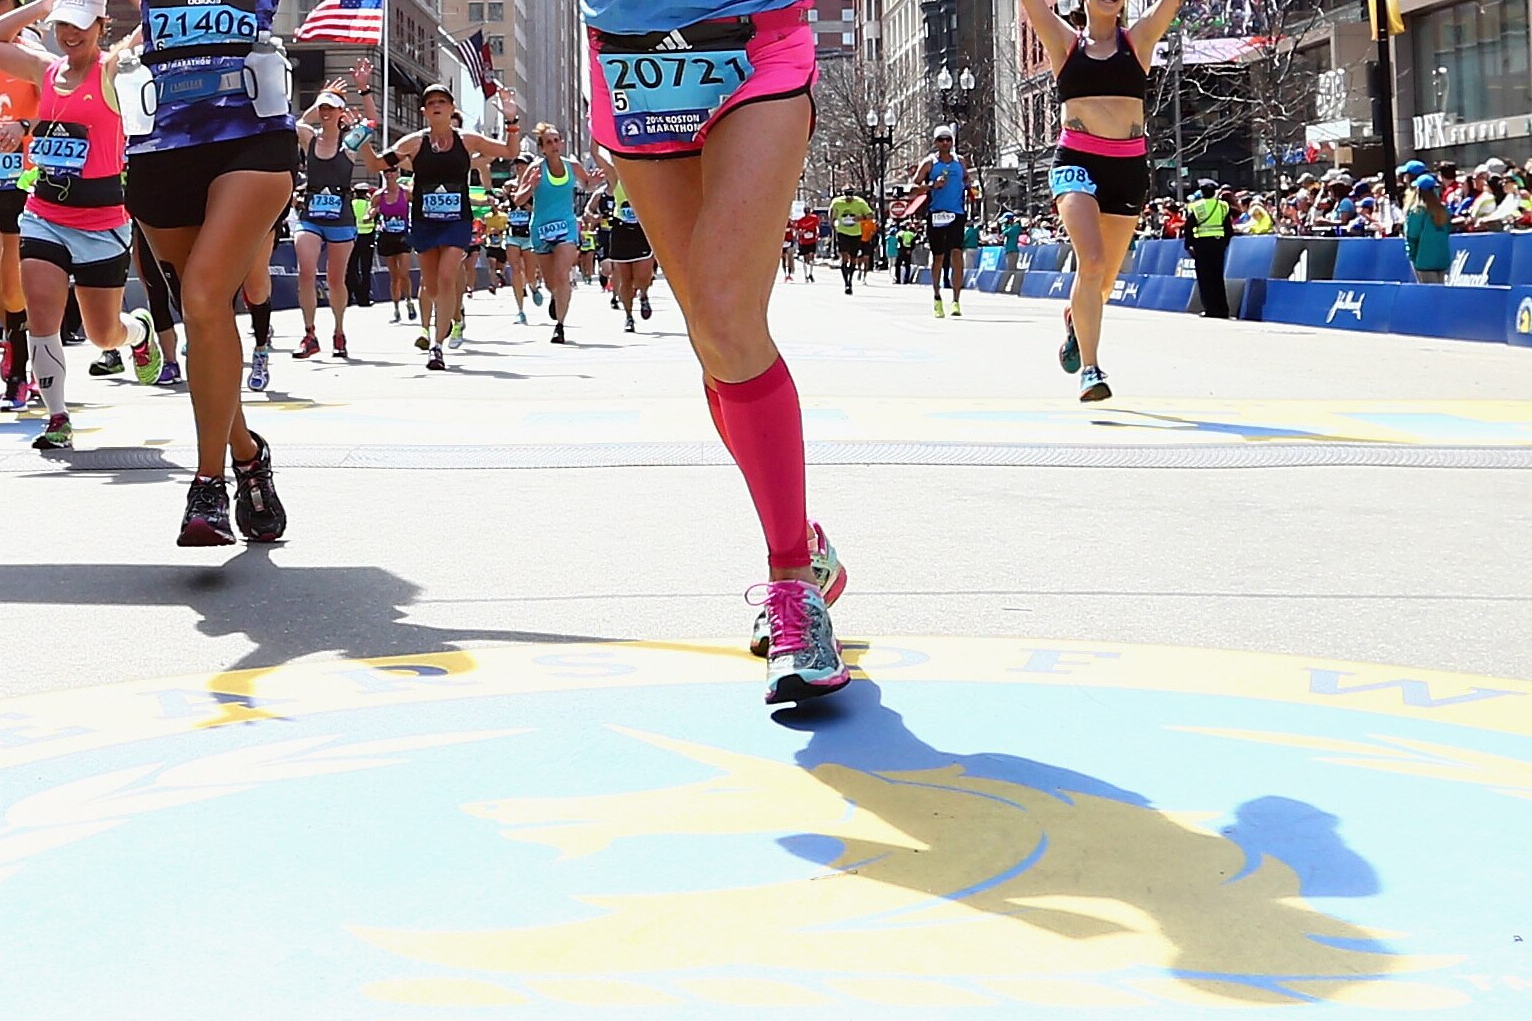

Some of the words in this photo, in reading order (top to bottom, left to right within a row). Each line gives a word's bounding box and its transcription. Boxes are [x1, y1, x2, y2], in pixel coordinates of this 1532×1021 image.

[153, 9, 255, 40] 21406
[605, 57, 747, 90] 20721
[614, 92, 629, 111] 5
[1412, 112, 1447, 151] BFX
